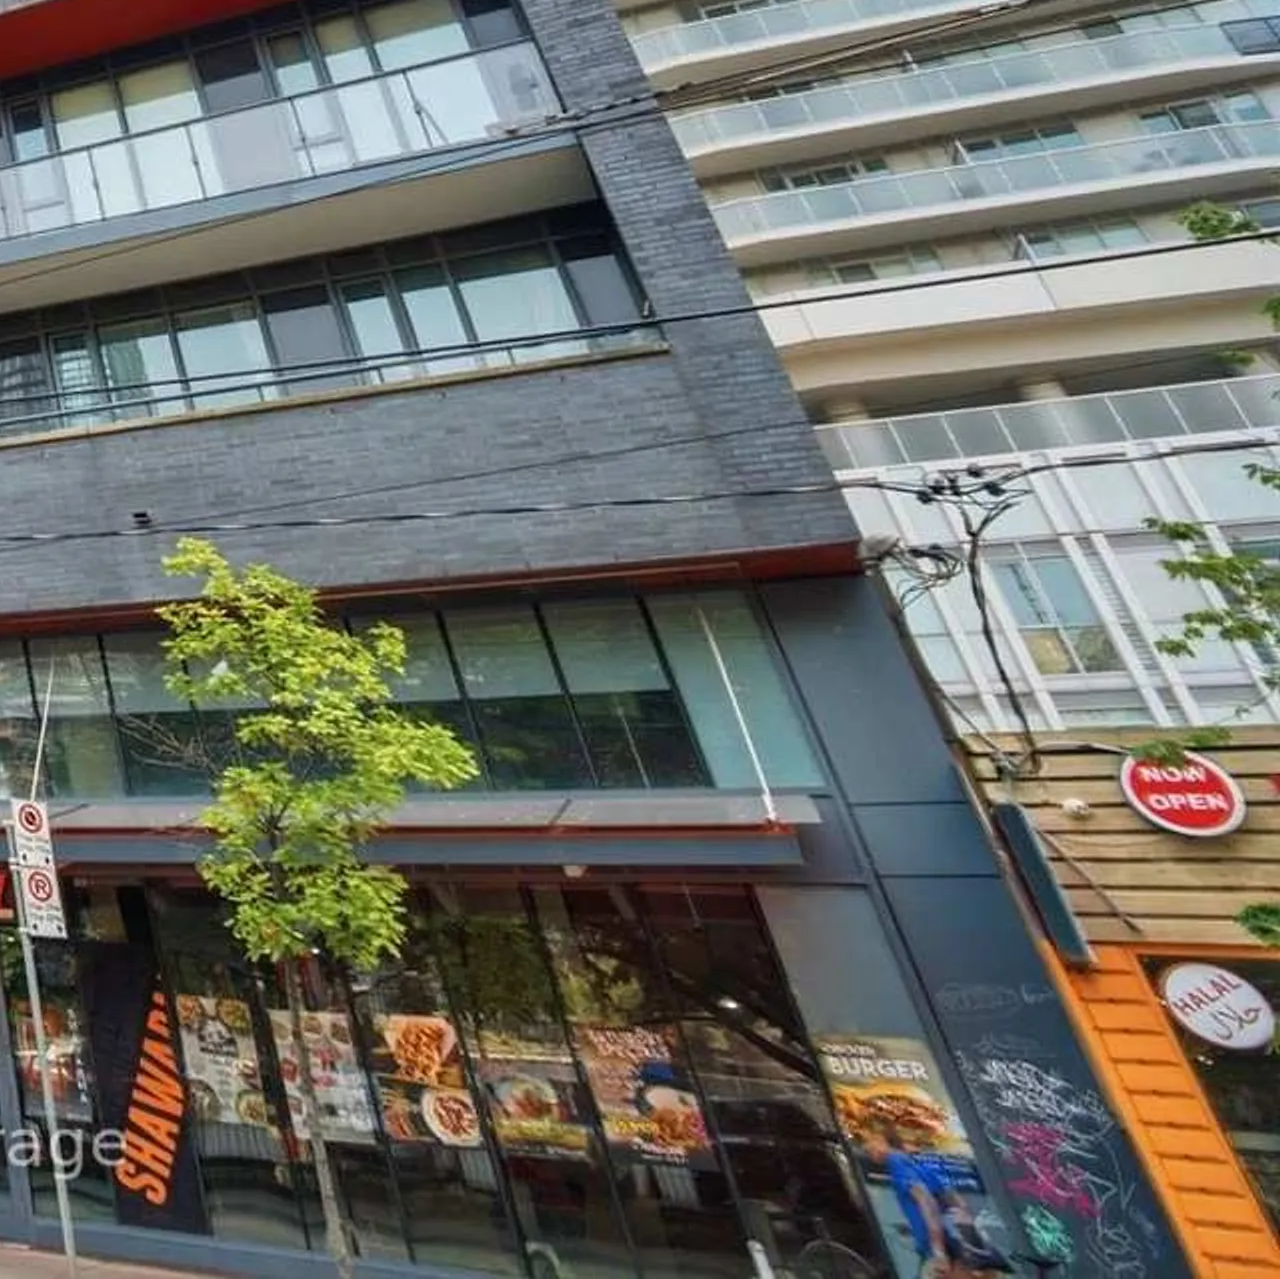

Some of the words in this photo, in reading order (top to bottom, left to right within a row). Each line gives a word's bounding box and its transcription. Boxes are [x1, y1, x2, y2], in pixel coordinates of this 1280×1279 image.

[1137, 766, 1207, 783] NOW
[1148, 793, 1230, 812] OPEN
[1173, 974, 1243, 1016] HALAL
[829, 1055, 931, 1081] BURGER
